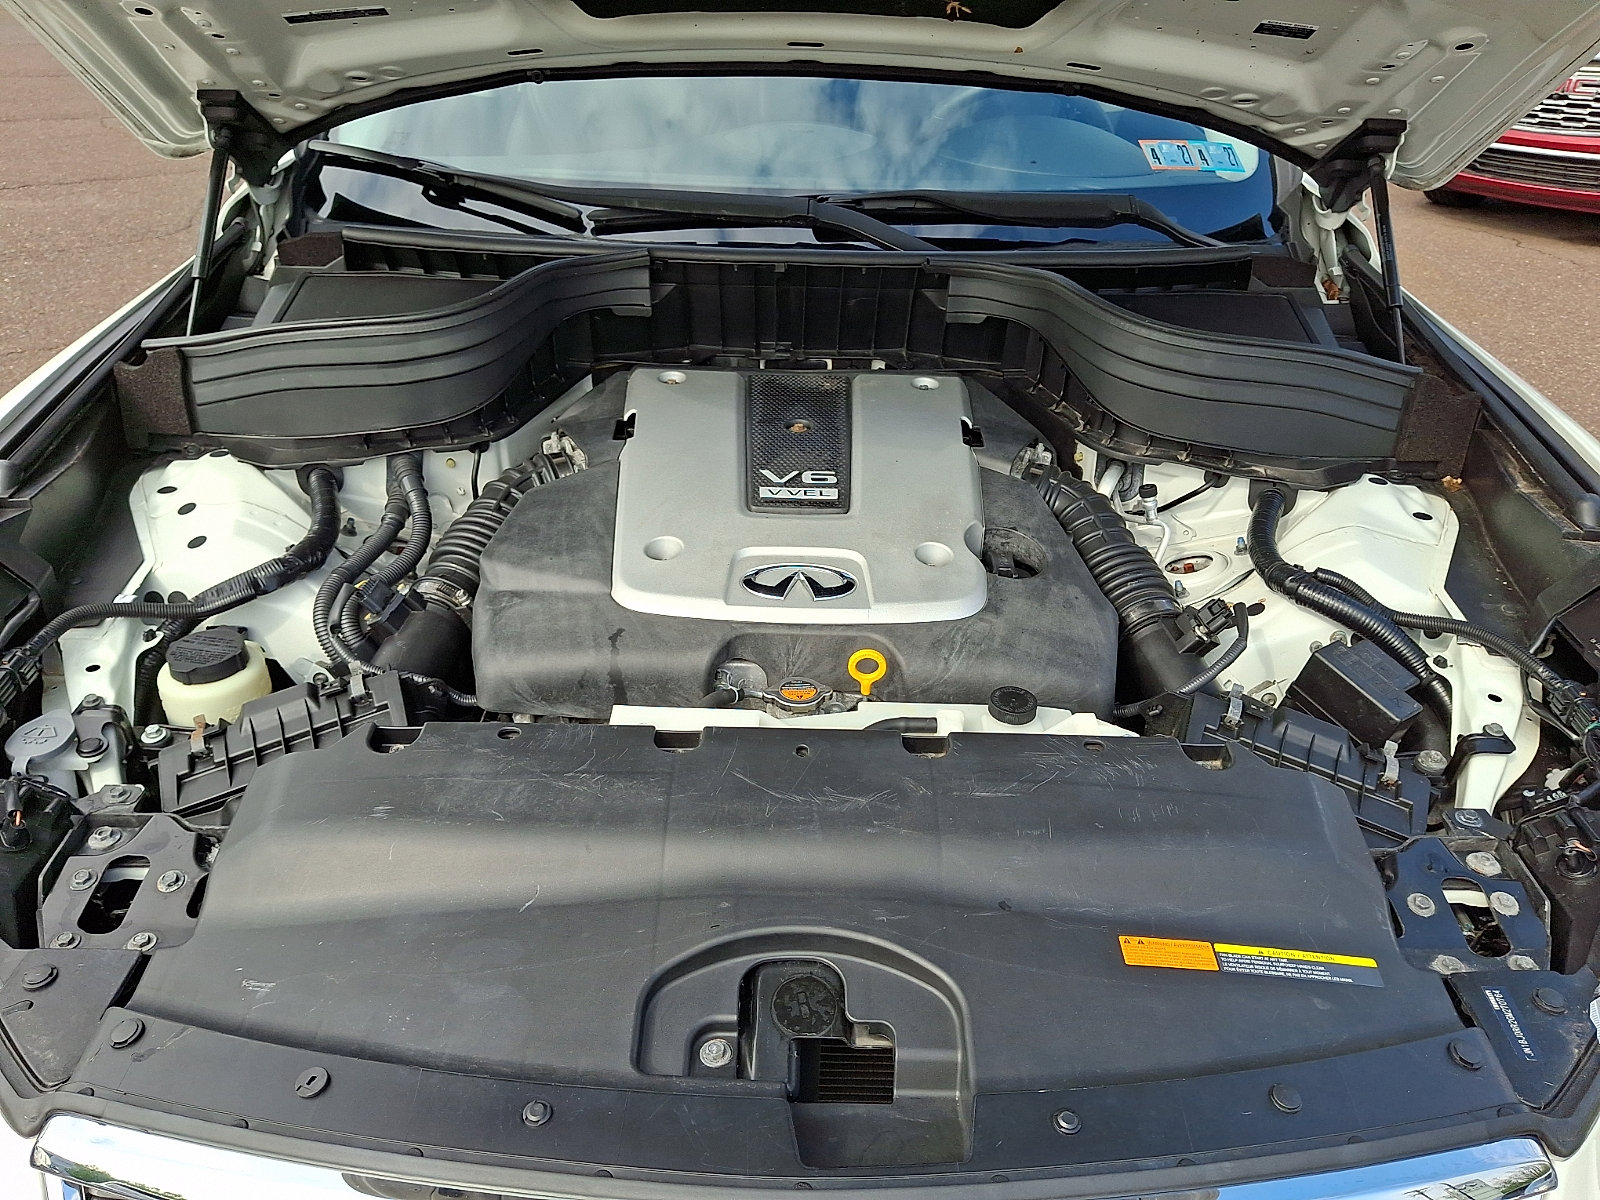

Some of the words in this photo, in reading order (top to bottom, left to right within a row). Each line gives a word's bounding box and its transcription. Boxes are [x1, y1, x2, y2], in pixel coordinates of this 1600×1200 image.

[1149, 147, 1162, 165] 4
[1197, 149, 1210, 167] 4
[758, 469, 838, 484] V6
[767, 489, 832, 497] VVEL
[1267, 949, 1296, 958] CAUTION
